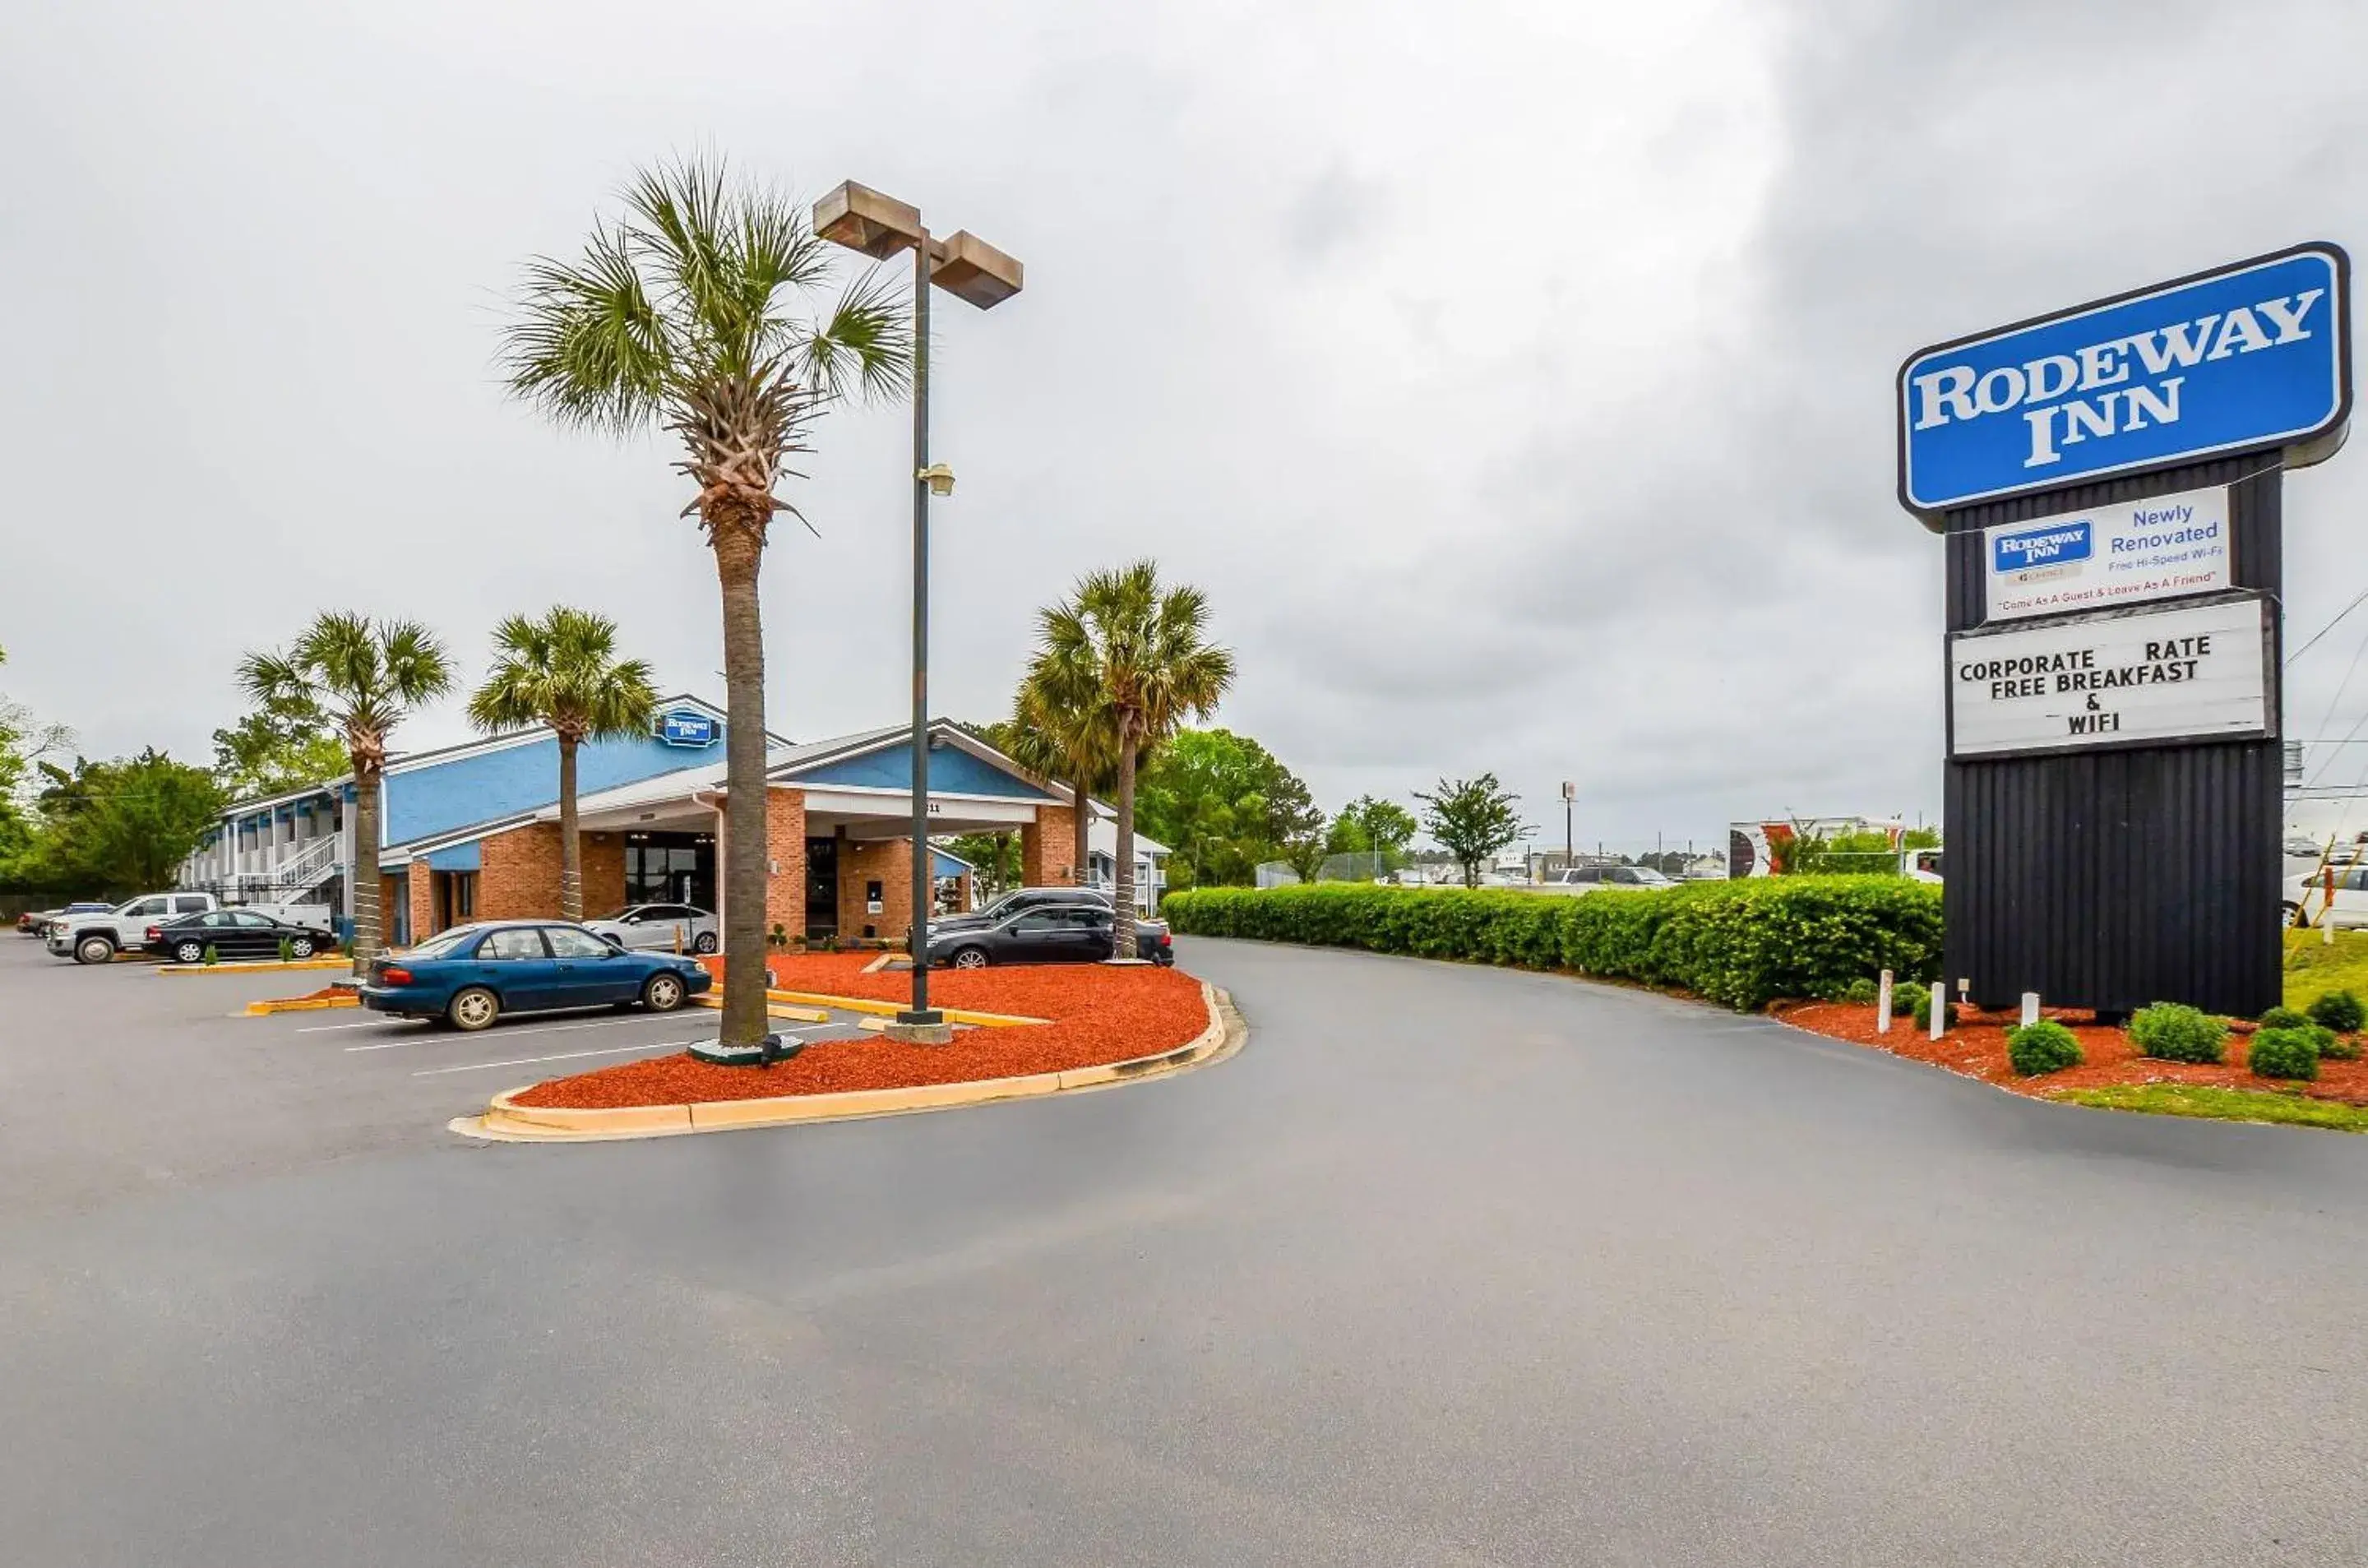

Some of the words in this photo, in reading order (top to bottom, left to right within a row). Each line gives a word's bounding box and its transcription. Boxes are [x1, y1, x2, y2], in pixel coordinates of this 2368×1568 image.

[1913, 288, 2324, 431] RODEWAY
[2023, 377, 2185, 469] INN
[2133, 505, 2193, 527] Newly
[2000, 530, 2085, 553] RODEWAY
[2111, 521, 2218, 553] Renovated
[2025, 544, 2060, 563] INN
[2108, 562, 2134, 571] Free
[2137, 553, 2188, 568] Hi-Speed
[2036, 596, 2048, 605] As
[2051, 594, 2059, 604] A
[2062, 590, 2093, 602] Guest
[2097, 588, 2104, 598] &
[2144, 580, 2159, 591] As
[2162, 578, 2170, 588] A
[1960, 650, 2094, 682] CORPORATE
[2146, 636, 2210, 661] RATE
[1991, 678, 2046, 701] FREE
[2056, 659, 2199, 693] BREAKFAST
[2086, 693, 2100, 710] &
[2069, 713, 2120, 735] WIFI
